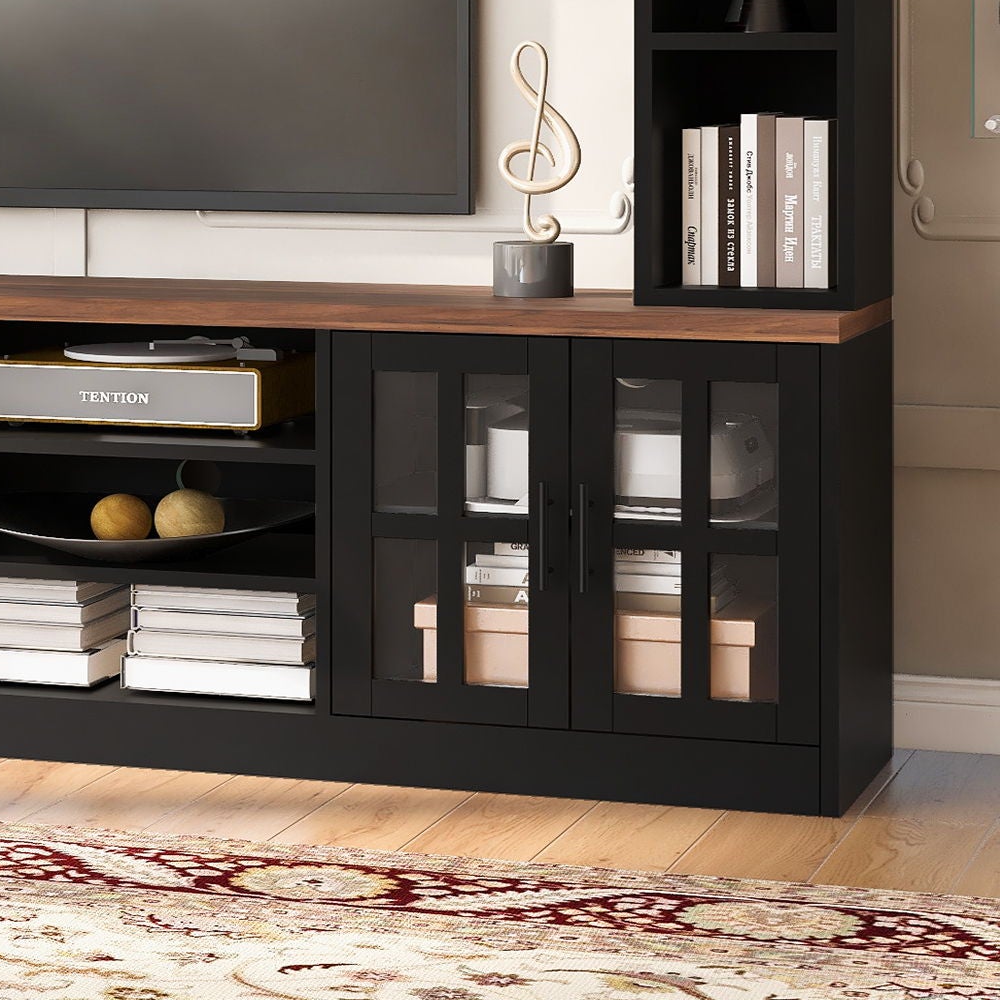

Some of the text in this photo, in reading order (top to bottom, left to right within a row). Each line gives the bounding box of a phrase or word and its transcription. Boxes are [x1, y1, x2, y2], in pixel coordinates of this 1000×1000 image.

[745, 168, 753, 193] Джобс
[686, 225, 698, 265] Спартак
[782, 194, 797, 262] Мартин Иден
[811, 214, 822, 269] ТРАКТАТЫ
[726, 241, 735, 272] стекла
[79, 390, 149, 405] TENTION
